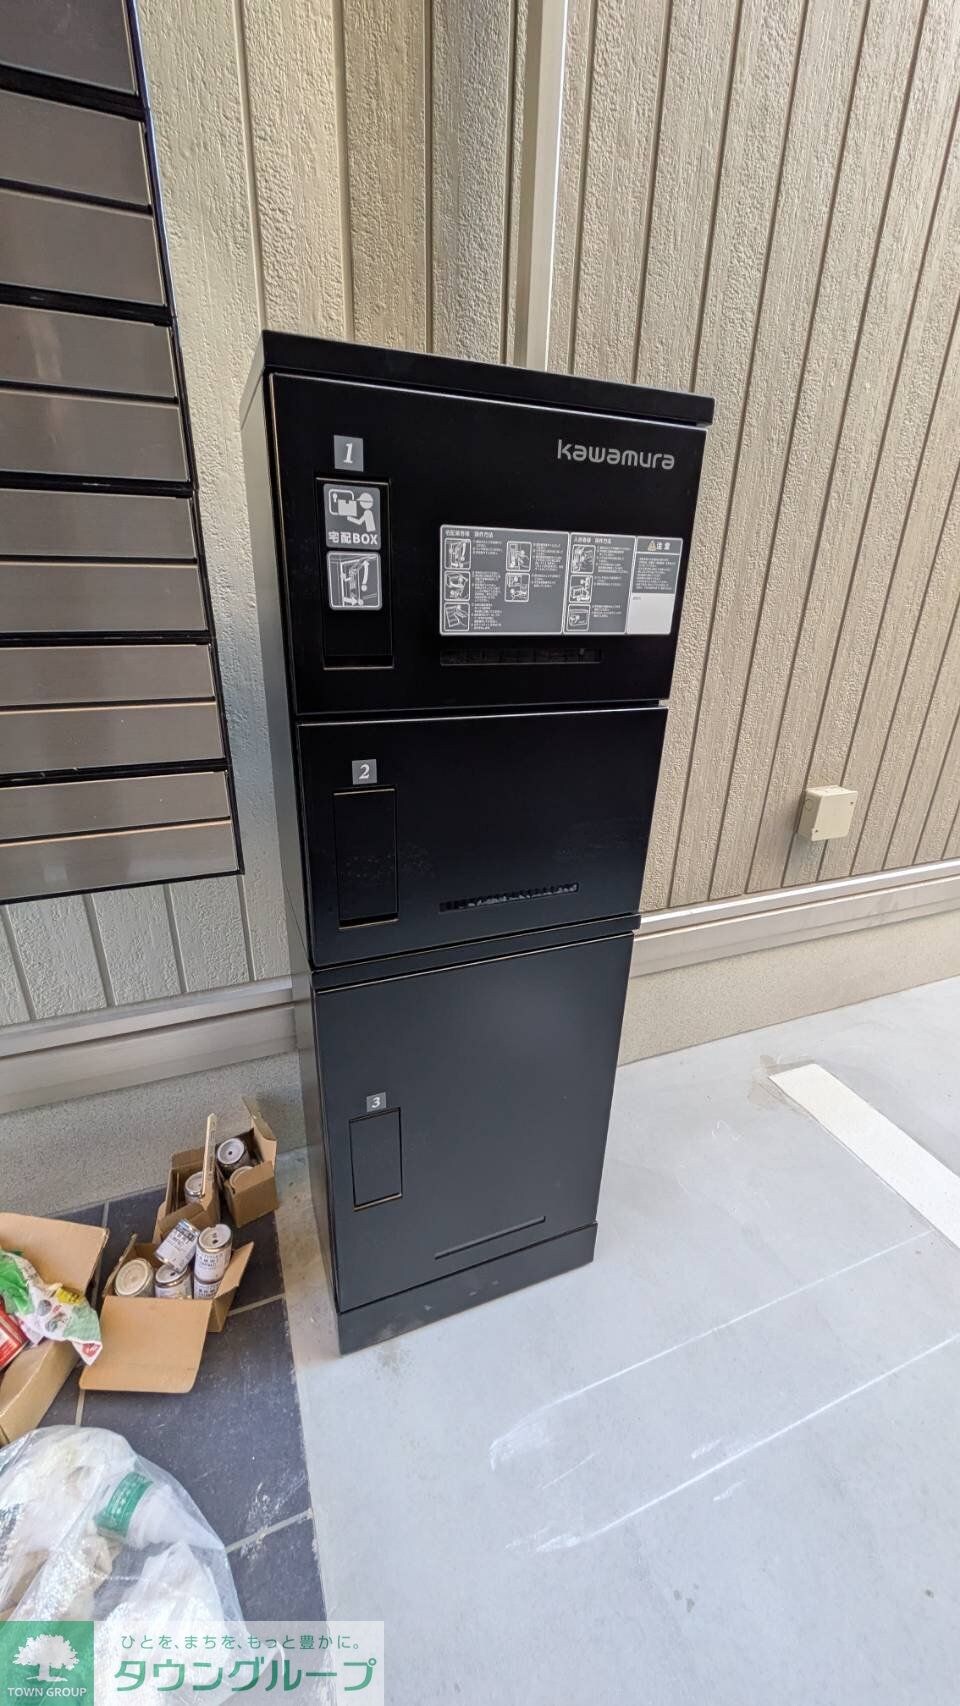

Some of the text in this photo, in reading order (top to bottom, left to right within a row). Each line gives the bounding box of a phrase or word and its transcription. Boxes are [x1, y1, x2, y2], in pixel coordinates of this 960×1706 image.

[343, 442, 354, 464] 1
[557, 439, 675, 470] kawamura
[328, 530, 378, 545] 宅配BOX
[358, 763, 370, 780] 2
[371, 1096, 381, 1109] 3
